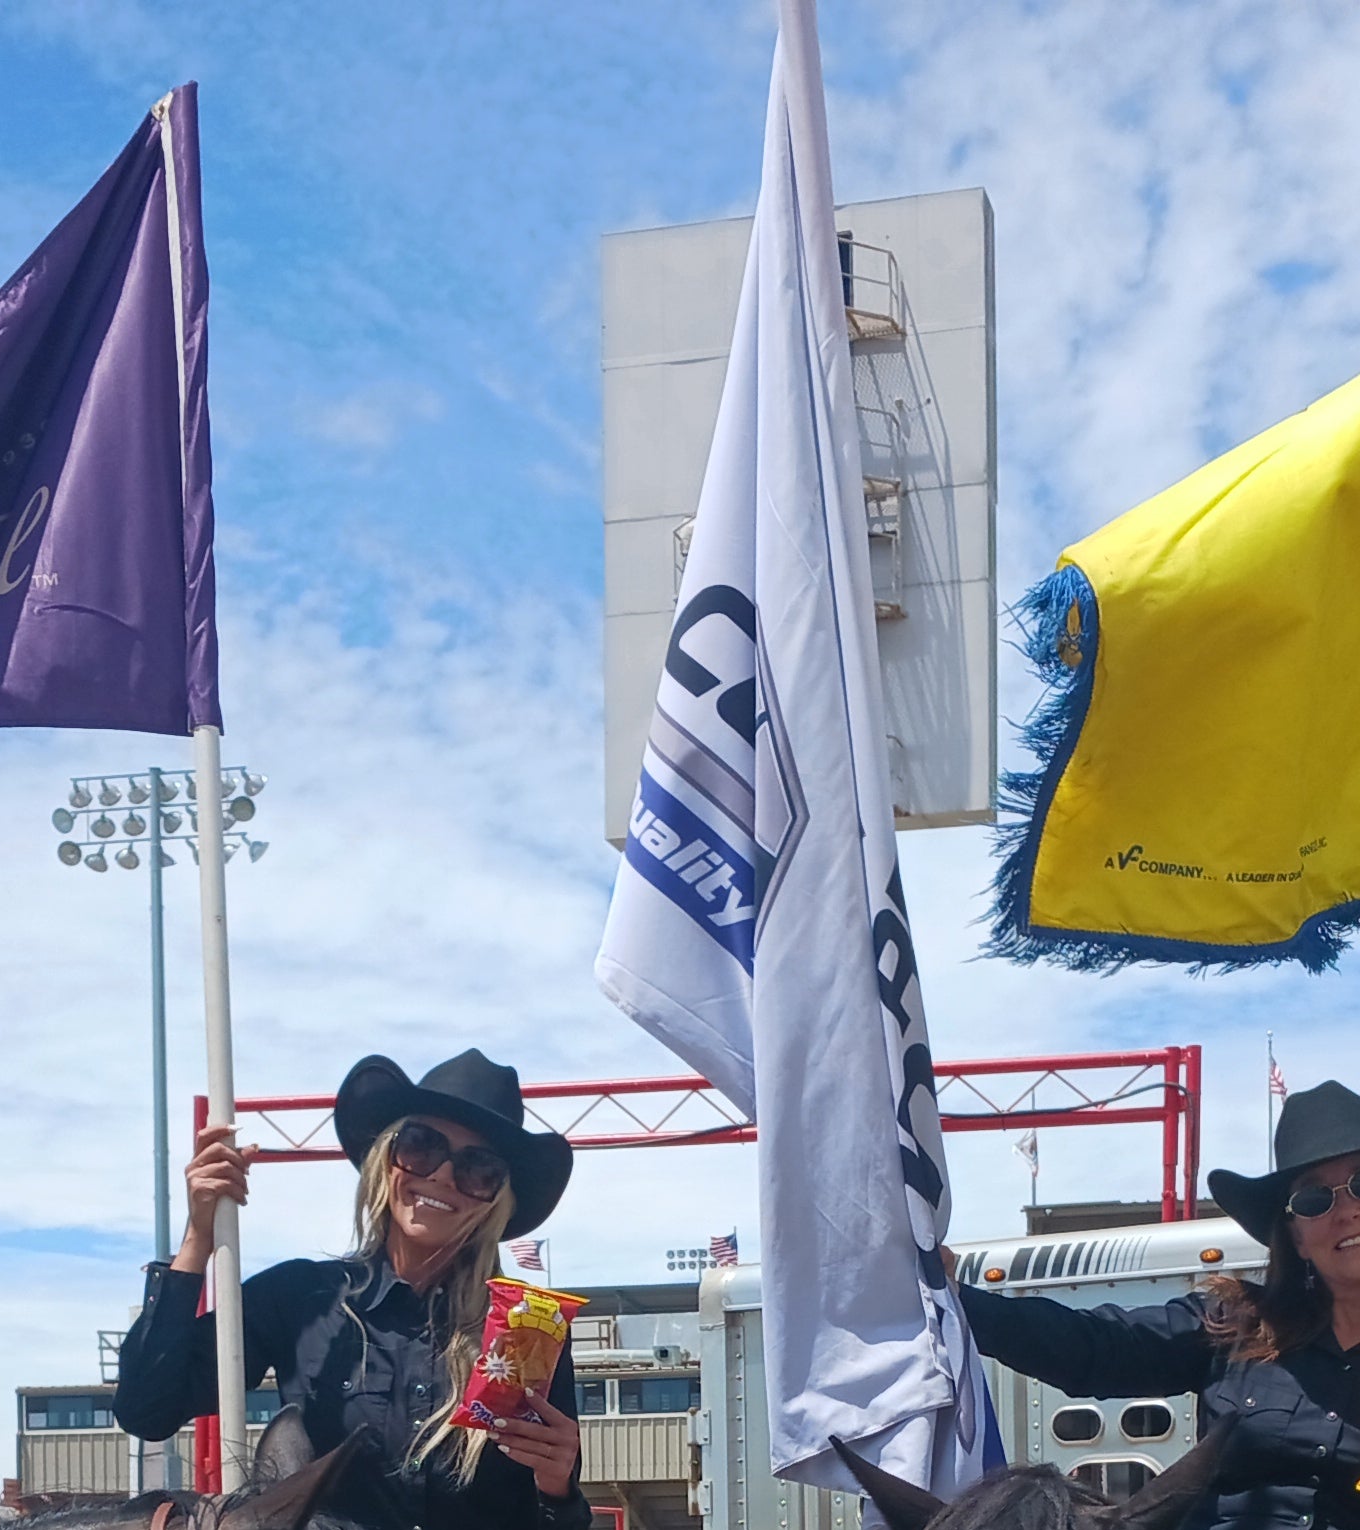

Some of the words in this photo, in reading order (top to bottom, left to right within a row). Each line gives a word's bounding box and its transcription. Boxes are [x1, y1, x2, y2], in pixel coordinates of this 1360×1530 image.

[627, 797, 755, 928] uality
[1104, 856, 1115, 870] A
[1226, 872, 1235, 882] A
[1236, 872, 1276, 883] LEADER
[1277, 872, 1288, 882] IN
